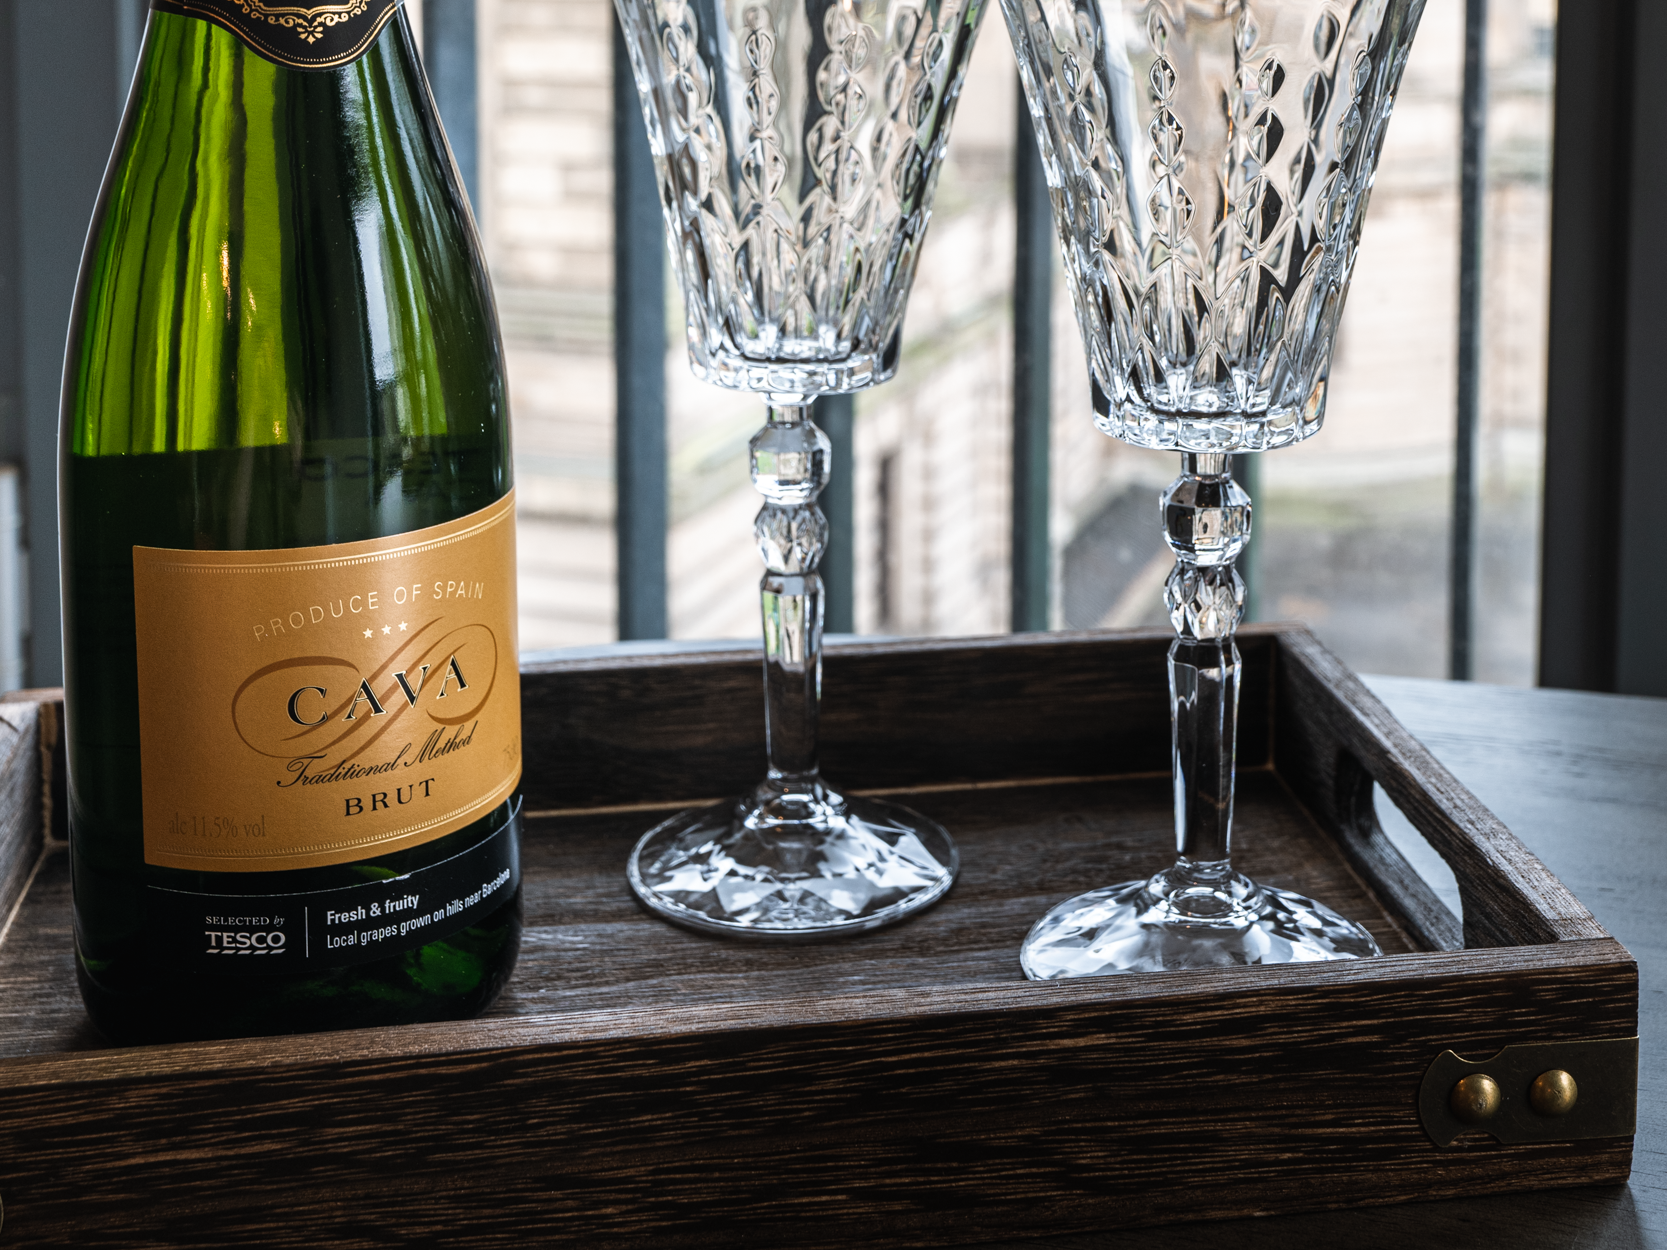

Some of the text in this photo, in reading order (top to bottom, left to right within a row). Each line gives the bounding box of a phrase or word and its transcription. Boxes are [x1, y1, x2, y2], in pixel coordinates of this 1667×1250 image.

[252, 580, 485, 642] PRODUCE OF SPAIN
[286, 654, 469, 727] CAVA
[276, 743, 411, 788] Traditional
[403, 720, 478, 768] Method
[344, 777, 436, 817] BRUT
[168, 812, 266, 838] alc 11.5% vol
[205, 915, 286, 927] SELECTED by
[326, 894, 420, 925] Fresh & fruity
[327, 868, 511, 949] Local grapes grown on hills near Barcelona
[205, 931, 286, 948] TESCO
